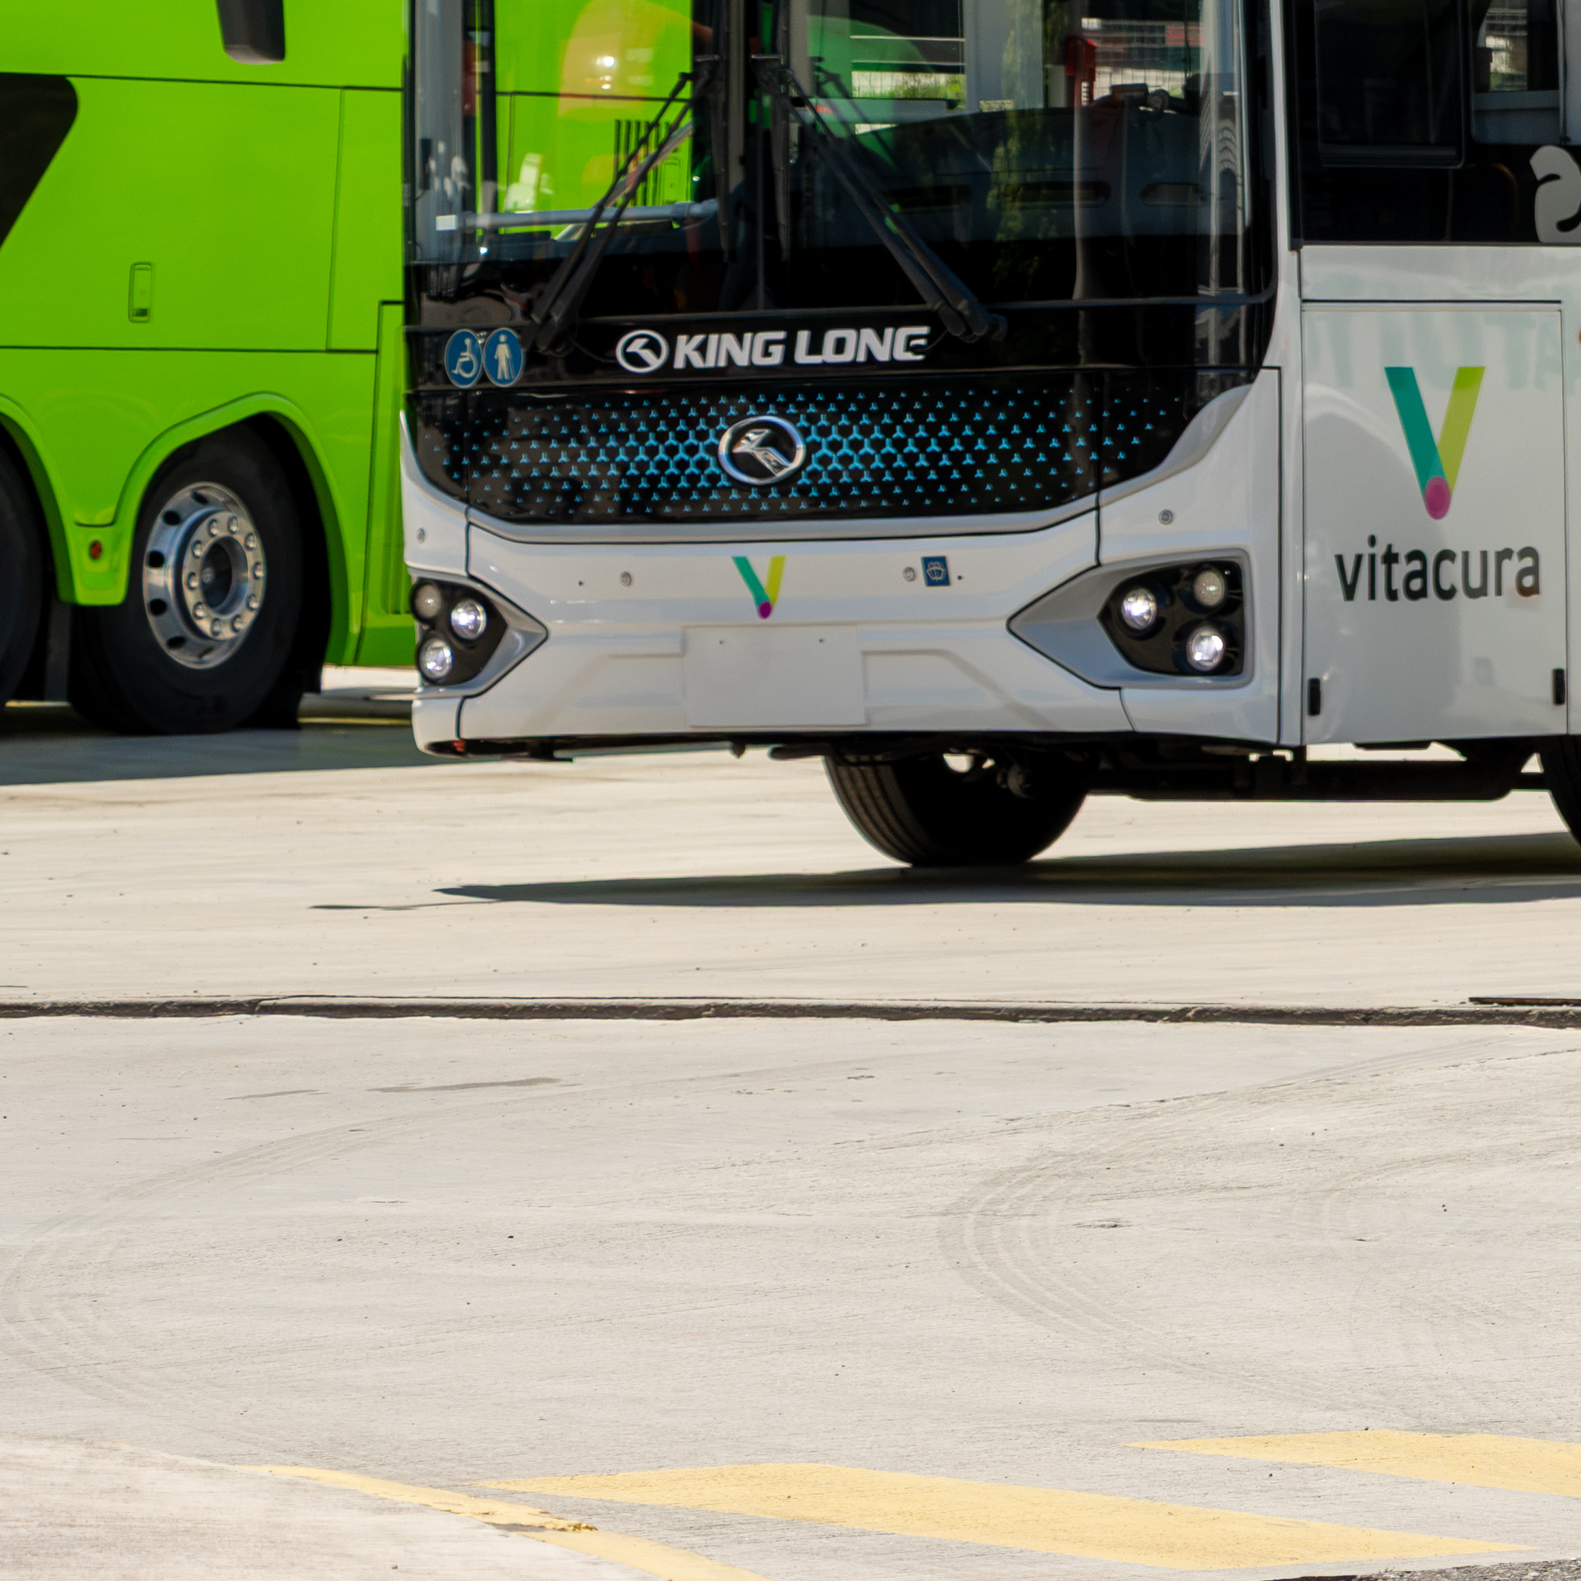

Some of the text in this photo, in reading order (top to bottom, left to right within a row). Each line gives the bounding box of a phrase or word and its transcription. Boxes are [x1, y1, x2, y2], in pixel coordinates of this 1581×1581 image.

[673, 325, 931, 369] KING LONG
[1334, 534, 1541, 602] vitacura
